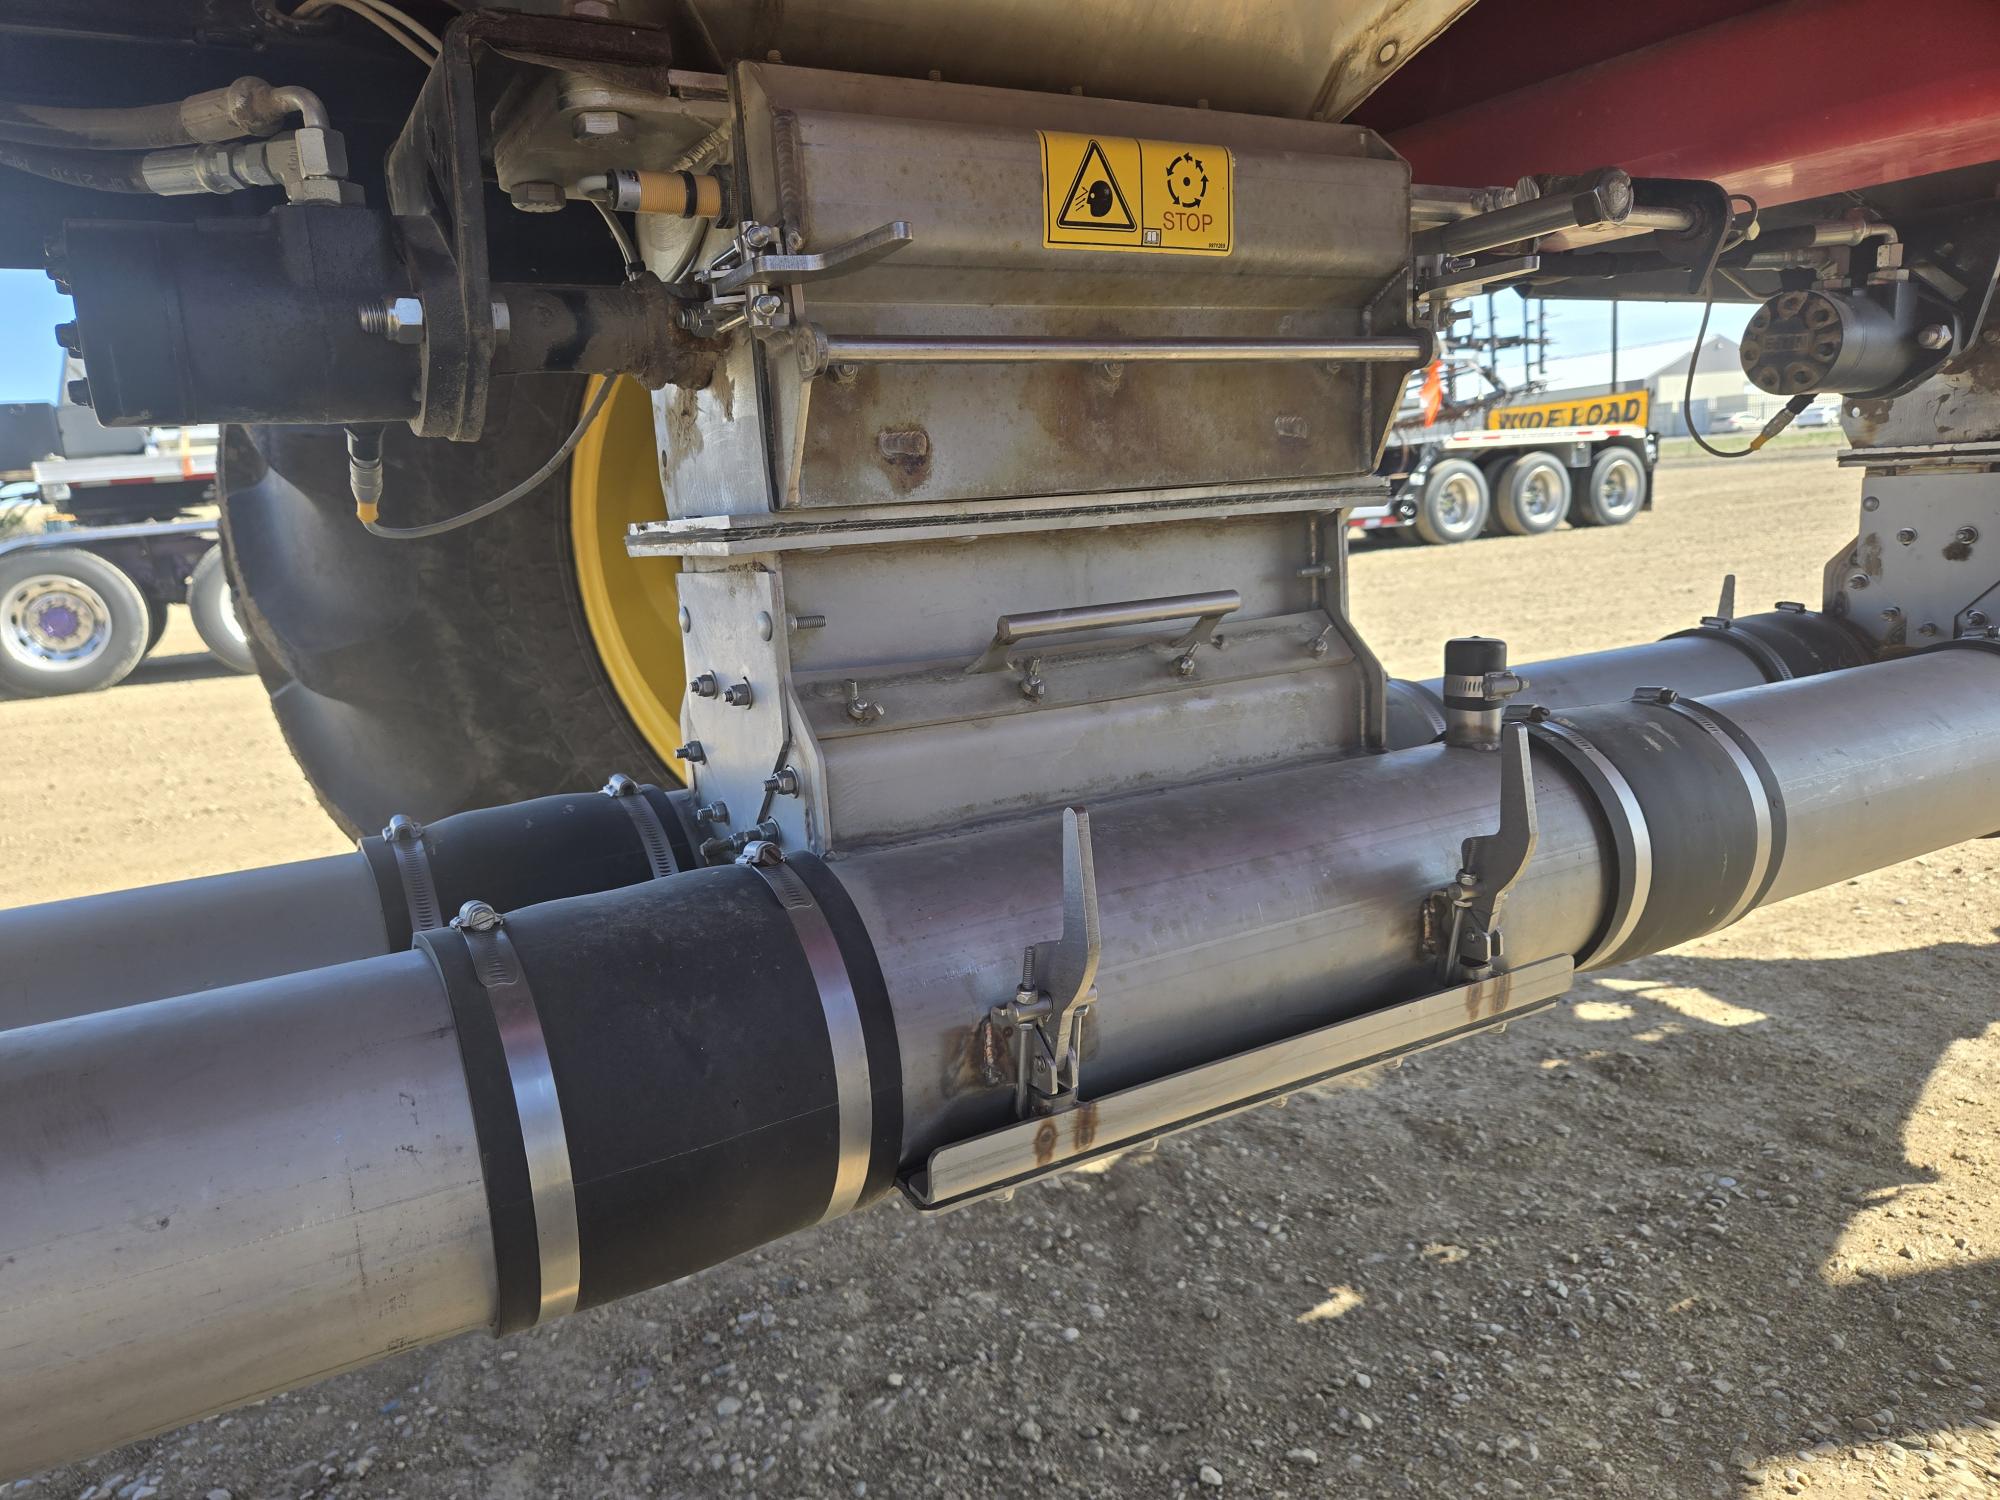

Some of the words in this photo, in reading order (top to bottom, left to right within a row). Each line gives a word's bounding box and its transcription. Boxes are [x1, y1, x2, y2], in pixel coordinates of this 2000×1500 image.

[1163, 211, 1213, 232] STOP
[1500, 409, 1565, 430] WIDE
[1569, 399, 1641, 427] LOAD
